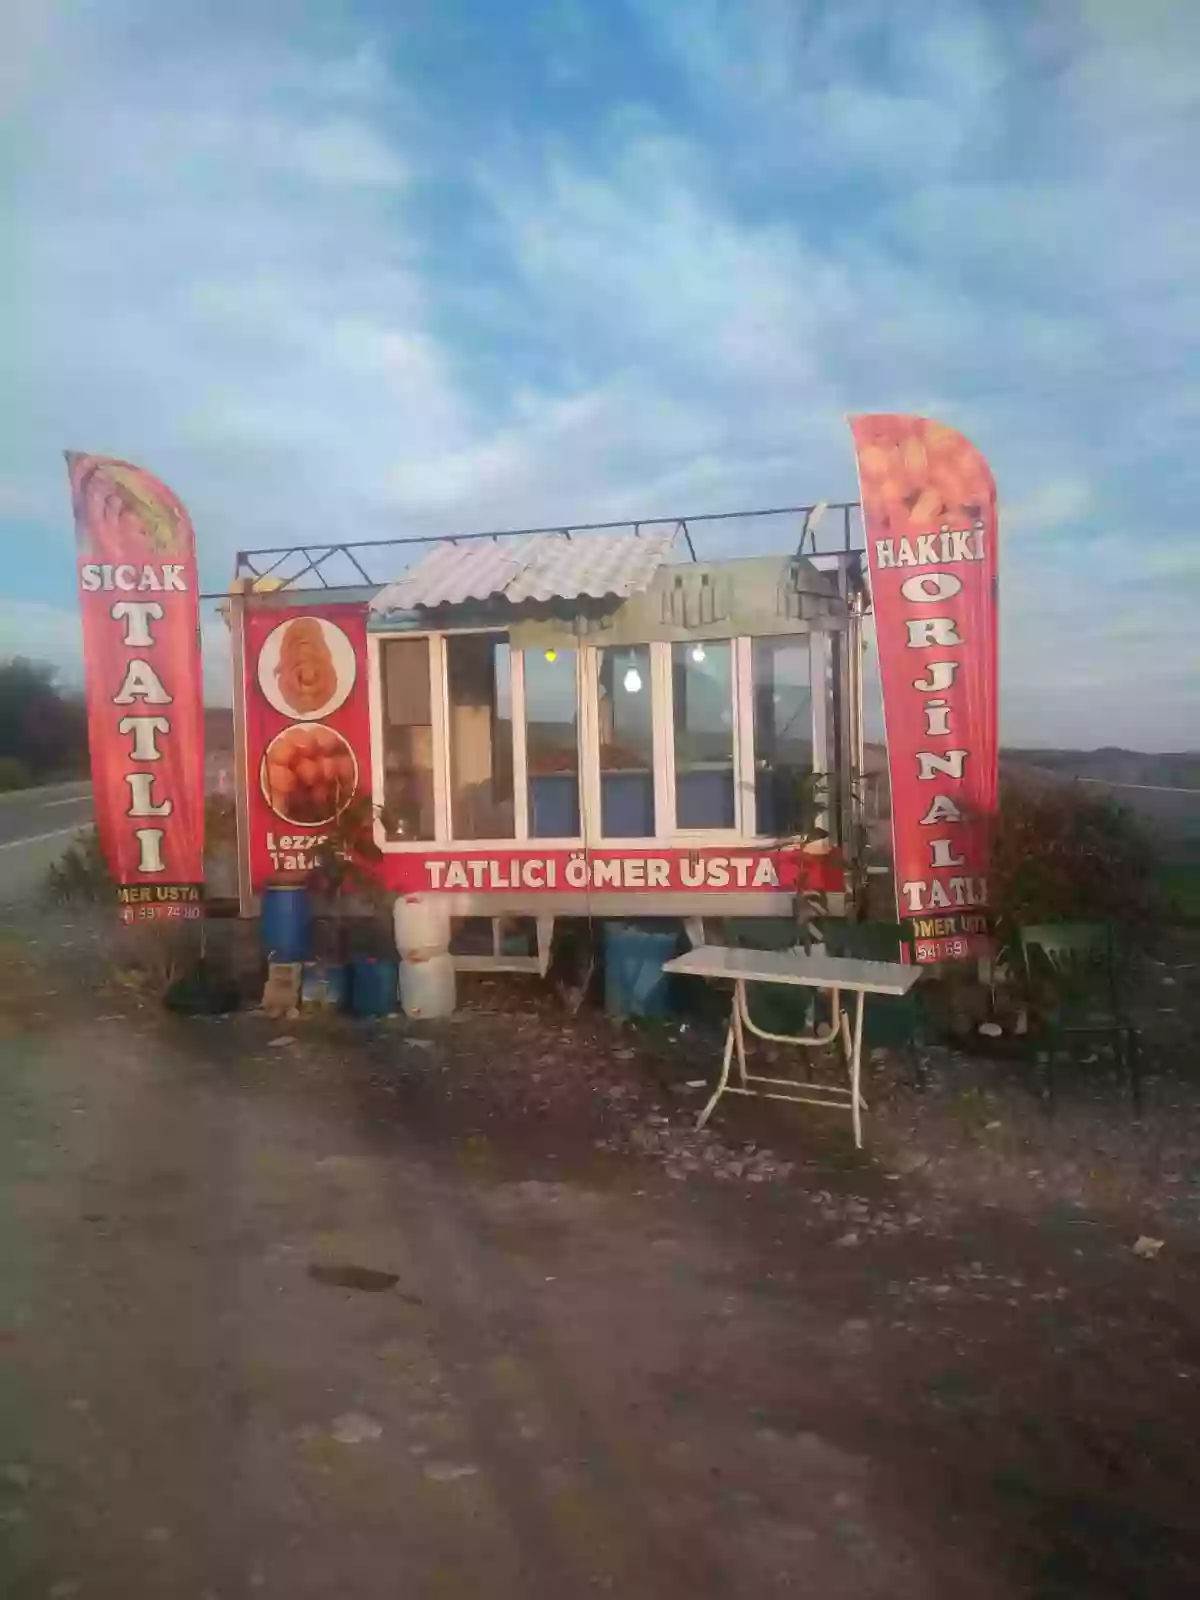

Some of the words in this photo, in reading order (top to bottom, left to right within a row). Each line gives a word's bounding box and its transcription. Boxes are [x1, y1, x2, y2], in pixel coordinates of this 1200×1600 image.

[874, 521, 986, 570] HAKİKİ
[81, 564, 188, 592] SICAK
[111, 601, 173, 873] TATLI
[900, 572, 970, 870] ORJİNAL
[266, 832, 329, 850] Lezz
[424, 857, 556, 889] TATLICI
[564, 852, 671, 888] ÖMER
[680, 857, 780, 887] USTA
[117, 887, 152, 902] MER
[156, 886, 199, 900] USTA
